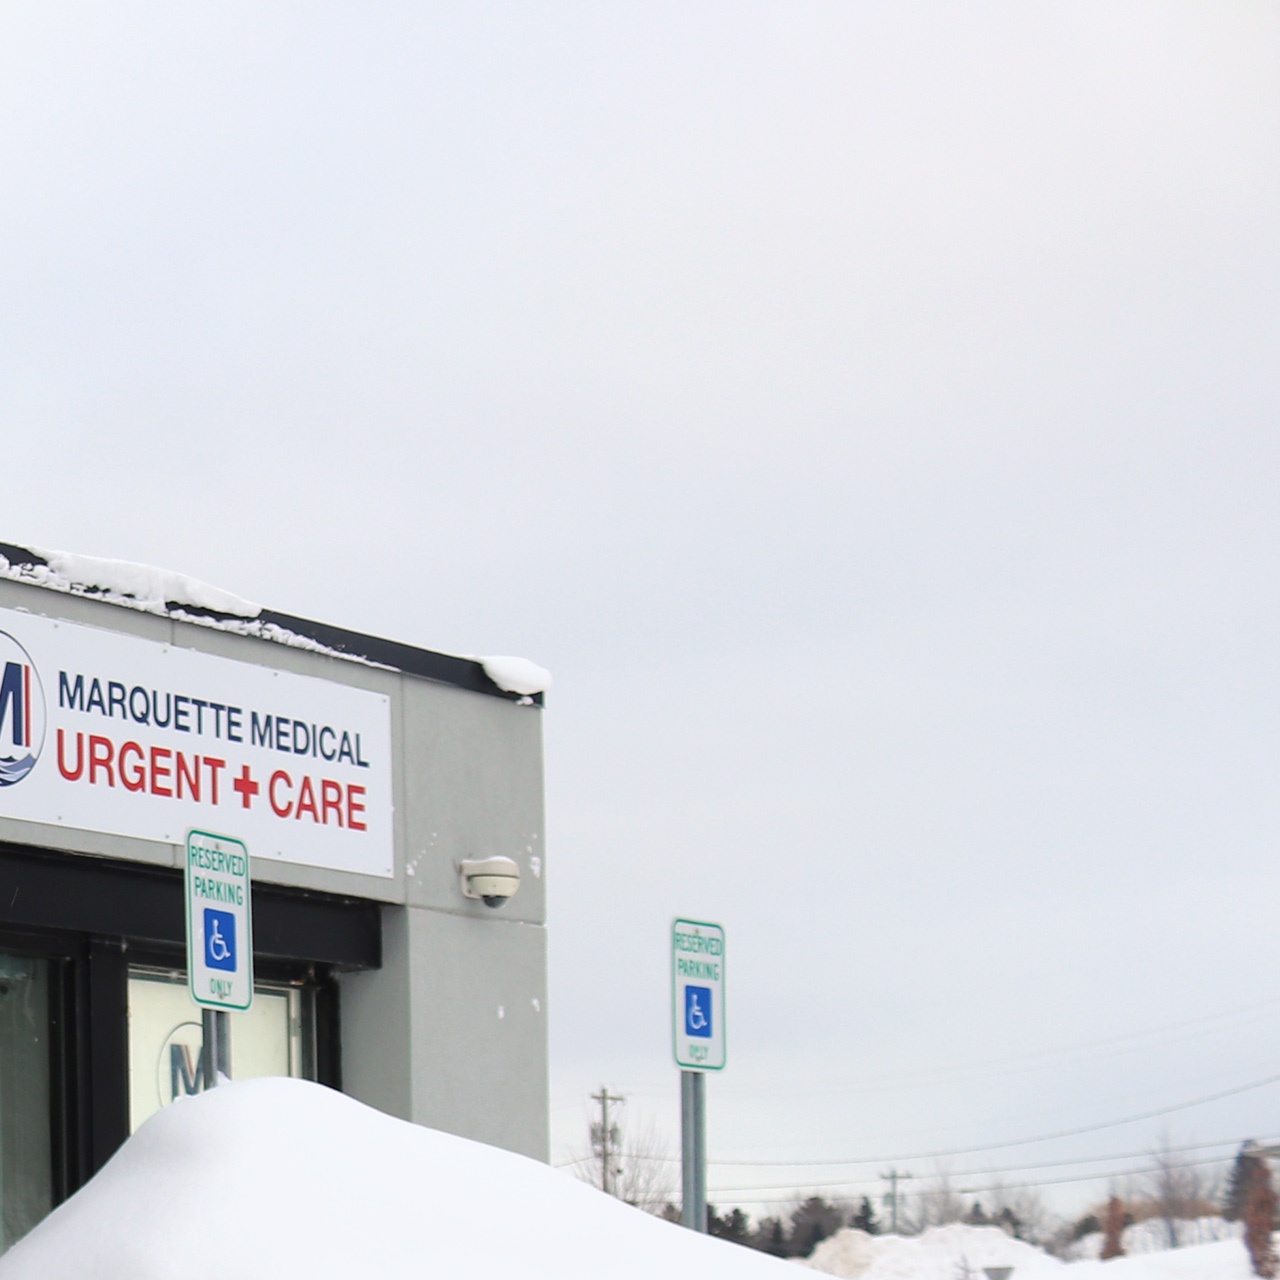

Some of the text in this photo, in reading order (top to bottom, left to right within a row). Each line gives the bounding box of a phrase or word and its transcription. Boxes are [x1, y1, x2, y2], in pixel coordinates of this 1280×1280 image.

[58, 670, 370, 769] MARQUETTE MEDICAL
[56, 728, 226, 807] URGENT
[268, 769, 368, 832] CARE
[191, 845, 246, 878] RESERVED
[194, 876, 243, 906] PARKING
[675, 932, 722, 956] RESERVED
[678, 959, 719, 981] PARKING
[210, 978, 233, 997] ONLY
